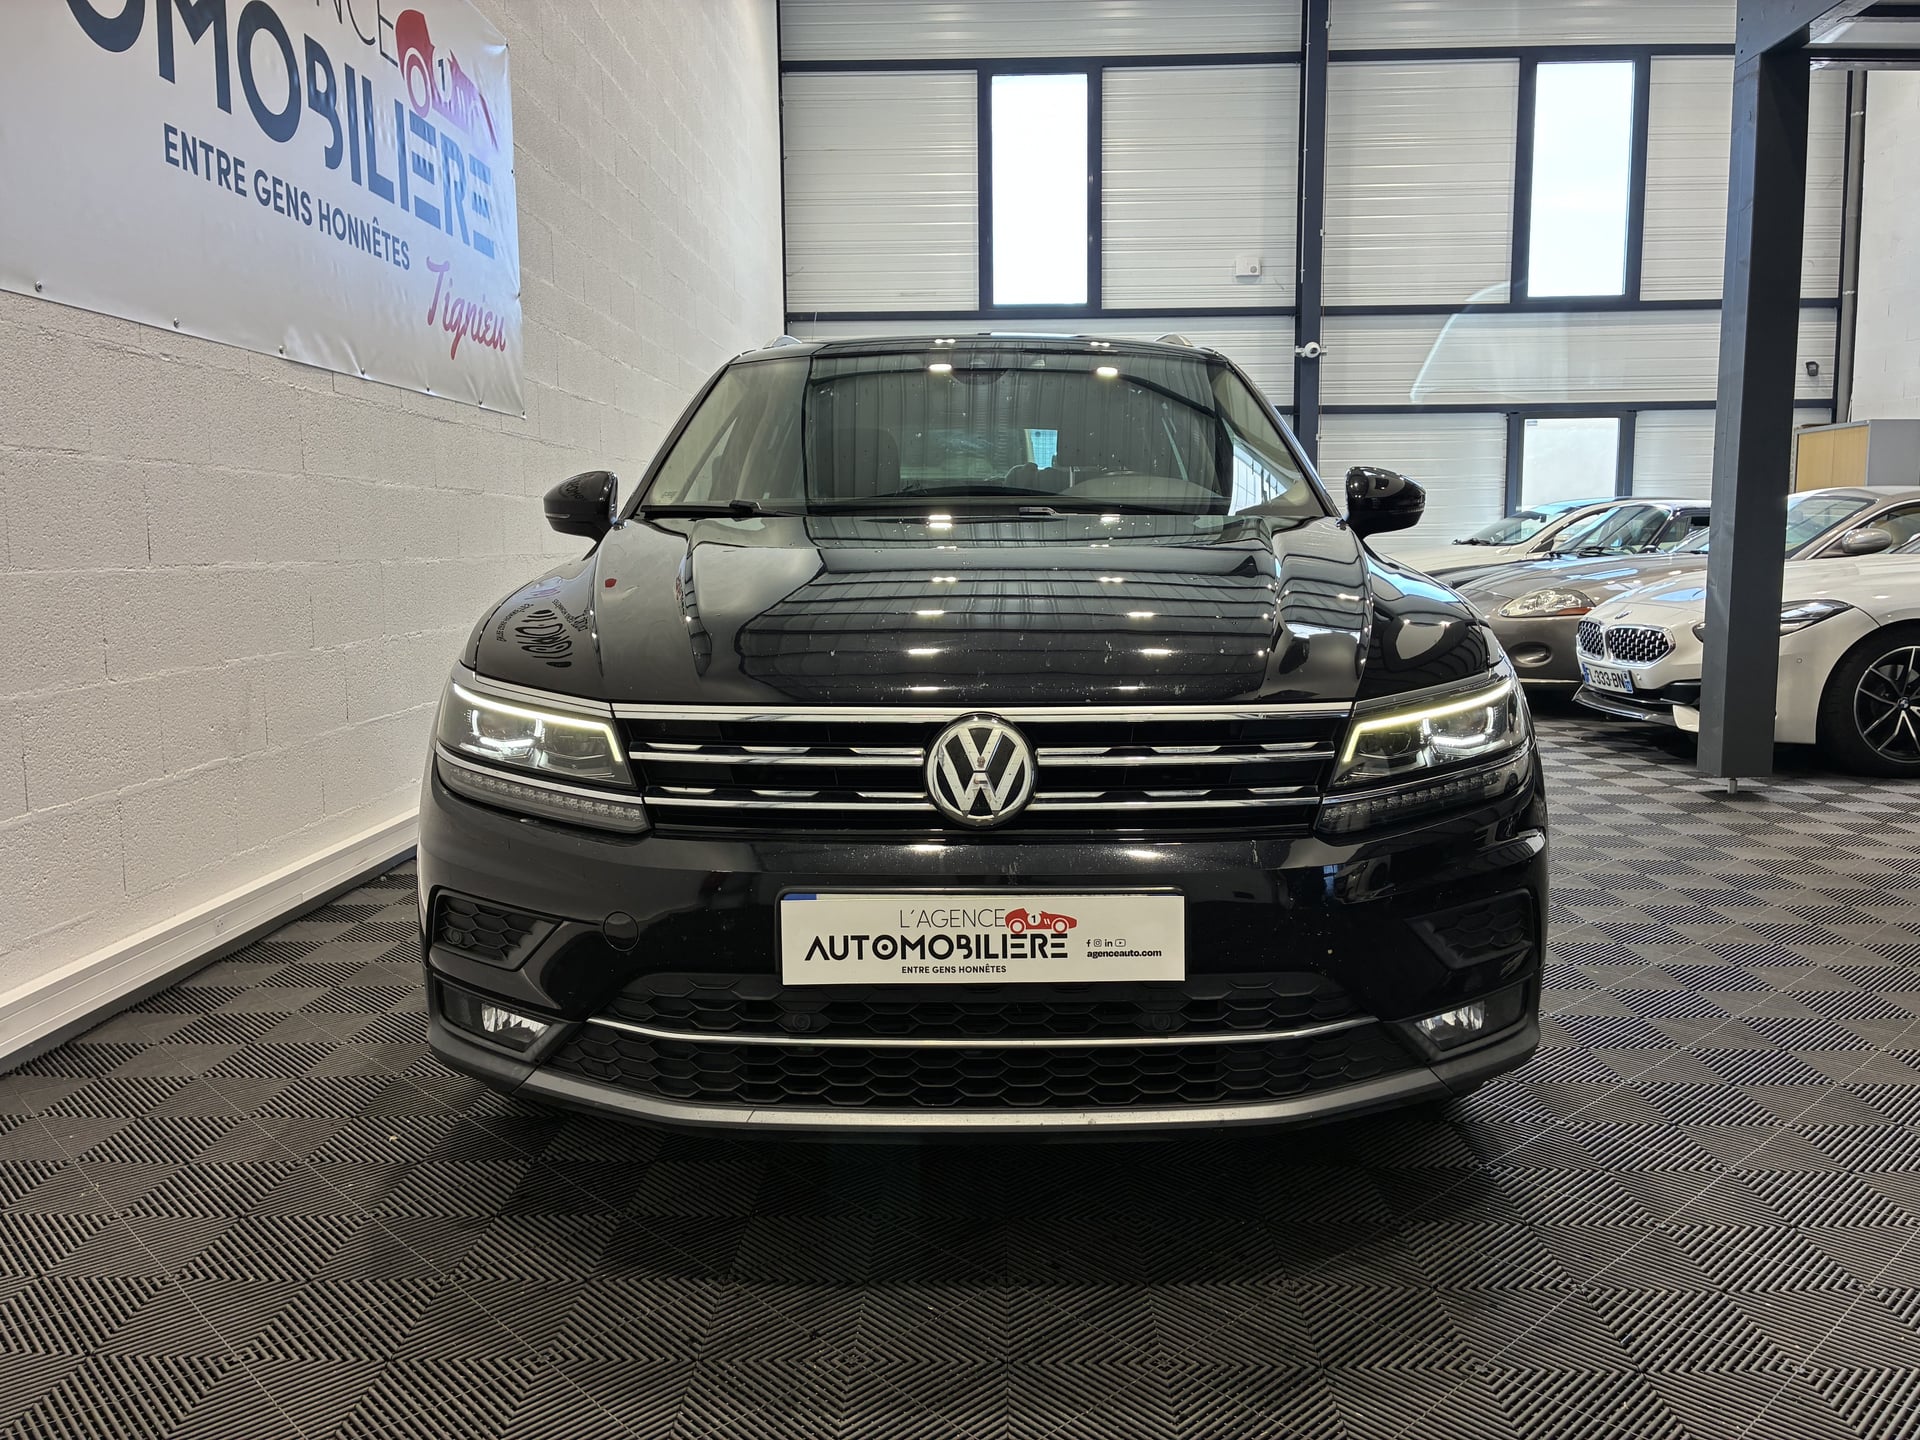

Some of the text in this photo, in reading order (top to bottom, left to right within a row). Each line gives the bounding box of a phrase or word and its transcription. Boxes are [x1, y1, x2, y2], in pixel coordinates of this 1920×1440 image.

[164, 122, 411, 271] ENTRE GENS HONNÊTES
[426, 256, 506, 361] Tignieu
[804, 933, 1068, 961] AUTOMOBILIERE
[1087, 949, 1162, 959] agenceauto.com
[901, 963, 1007, 974] ENTRE GENS HONNÊTES
